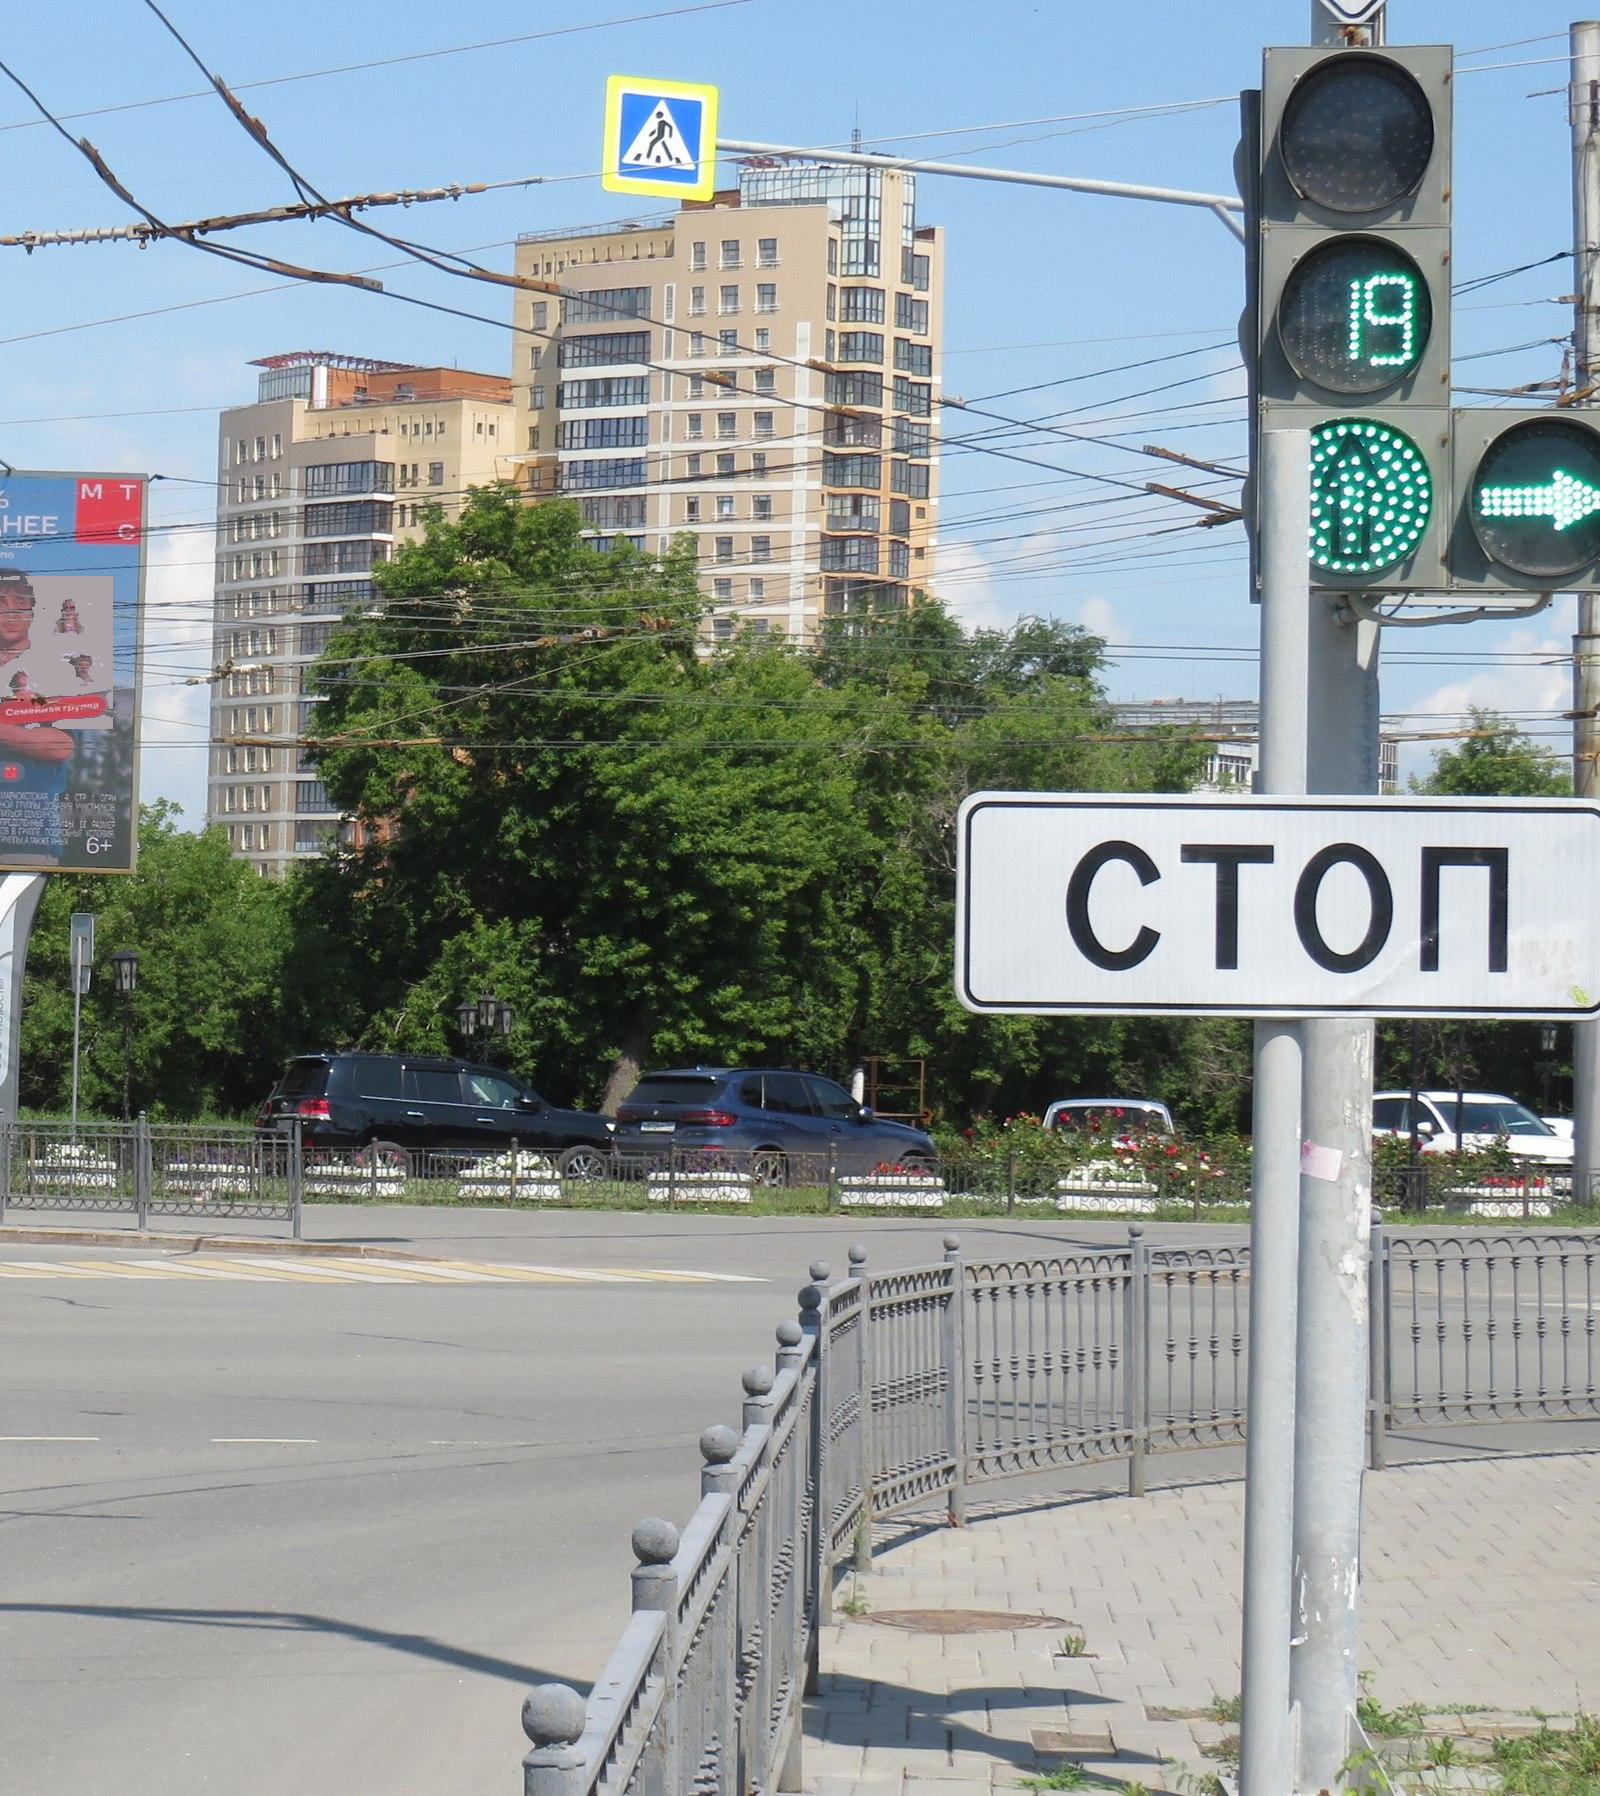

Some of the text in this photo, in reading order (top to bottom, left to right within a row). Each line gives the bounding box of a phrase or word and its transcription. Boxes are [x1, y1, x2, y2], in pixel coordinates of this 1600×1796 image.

[1348, 272, 1414, 367] 19
[85, 836, 113, 854] 6+
[1065, 839, 1509, 974] СТОП
